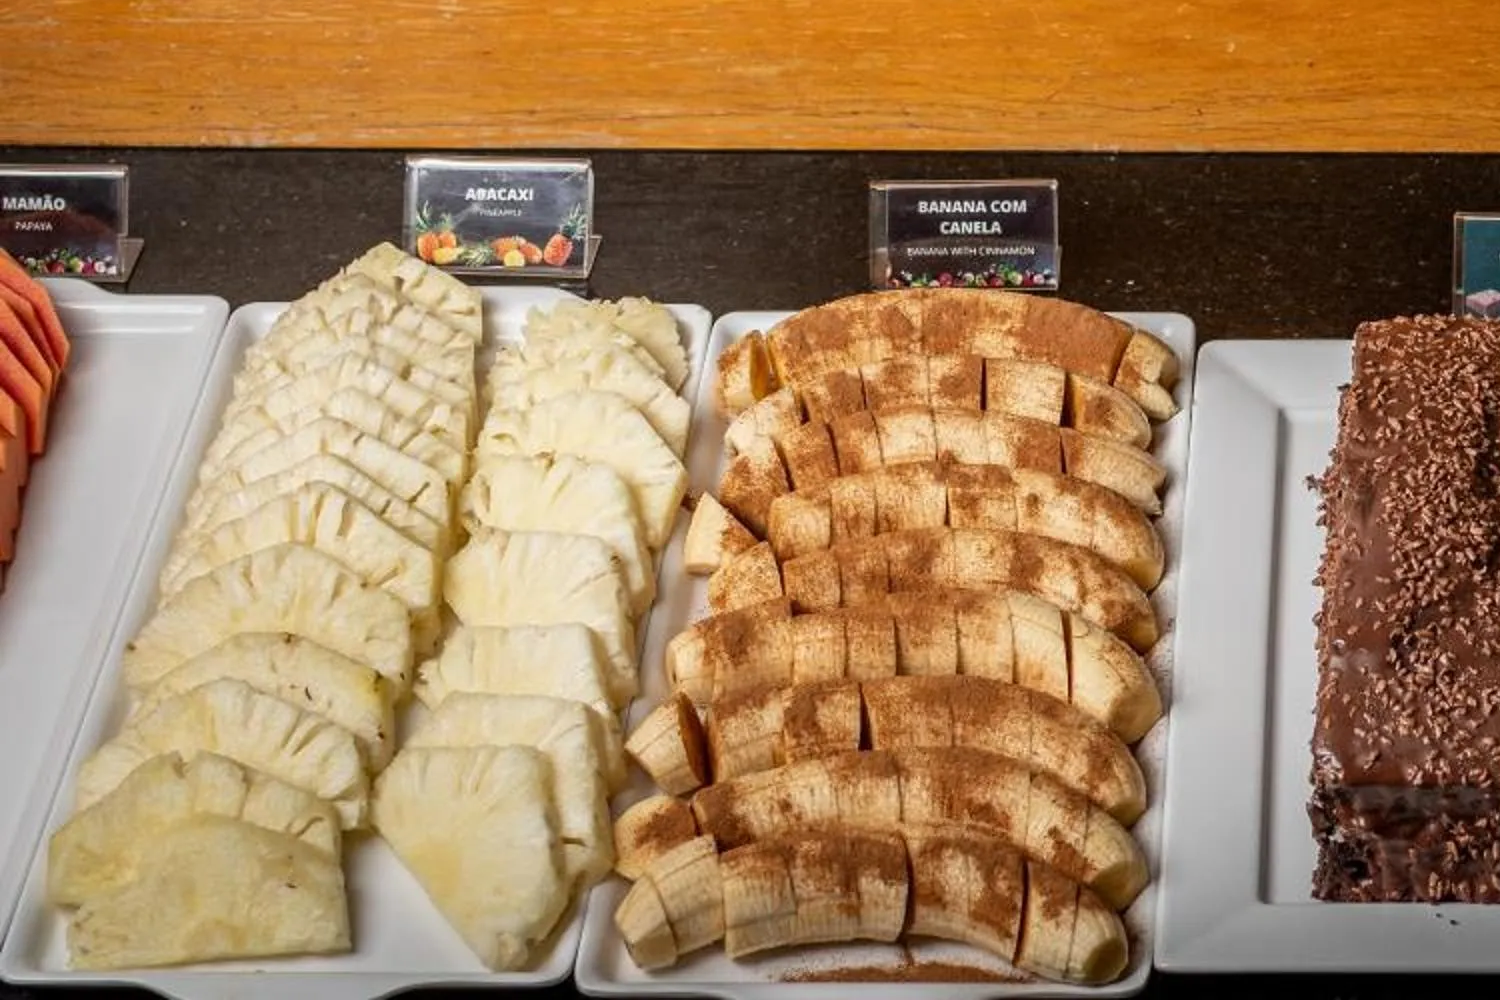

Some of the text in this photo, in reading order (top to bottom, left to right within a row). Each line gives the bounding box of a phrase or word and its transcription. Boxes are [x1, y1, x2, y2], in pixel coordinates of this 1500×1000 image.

[465, 187, 534, 201] ABACAXI
[3, 194, 66, 210] MAMÃO
[918, 199, 1027, 213] BANANA COM
[15, 222, 53, 231] PAPAYA
[940, 221, 1002, 235] CANELA
[907, 247, 1035, 256] BANANA WITH CINNAMON
